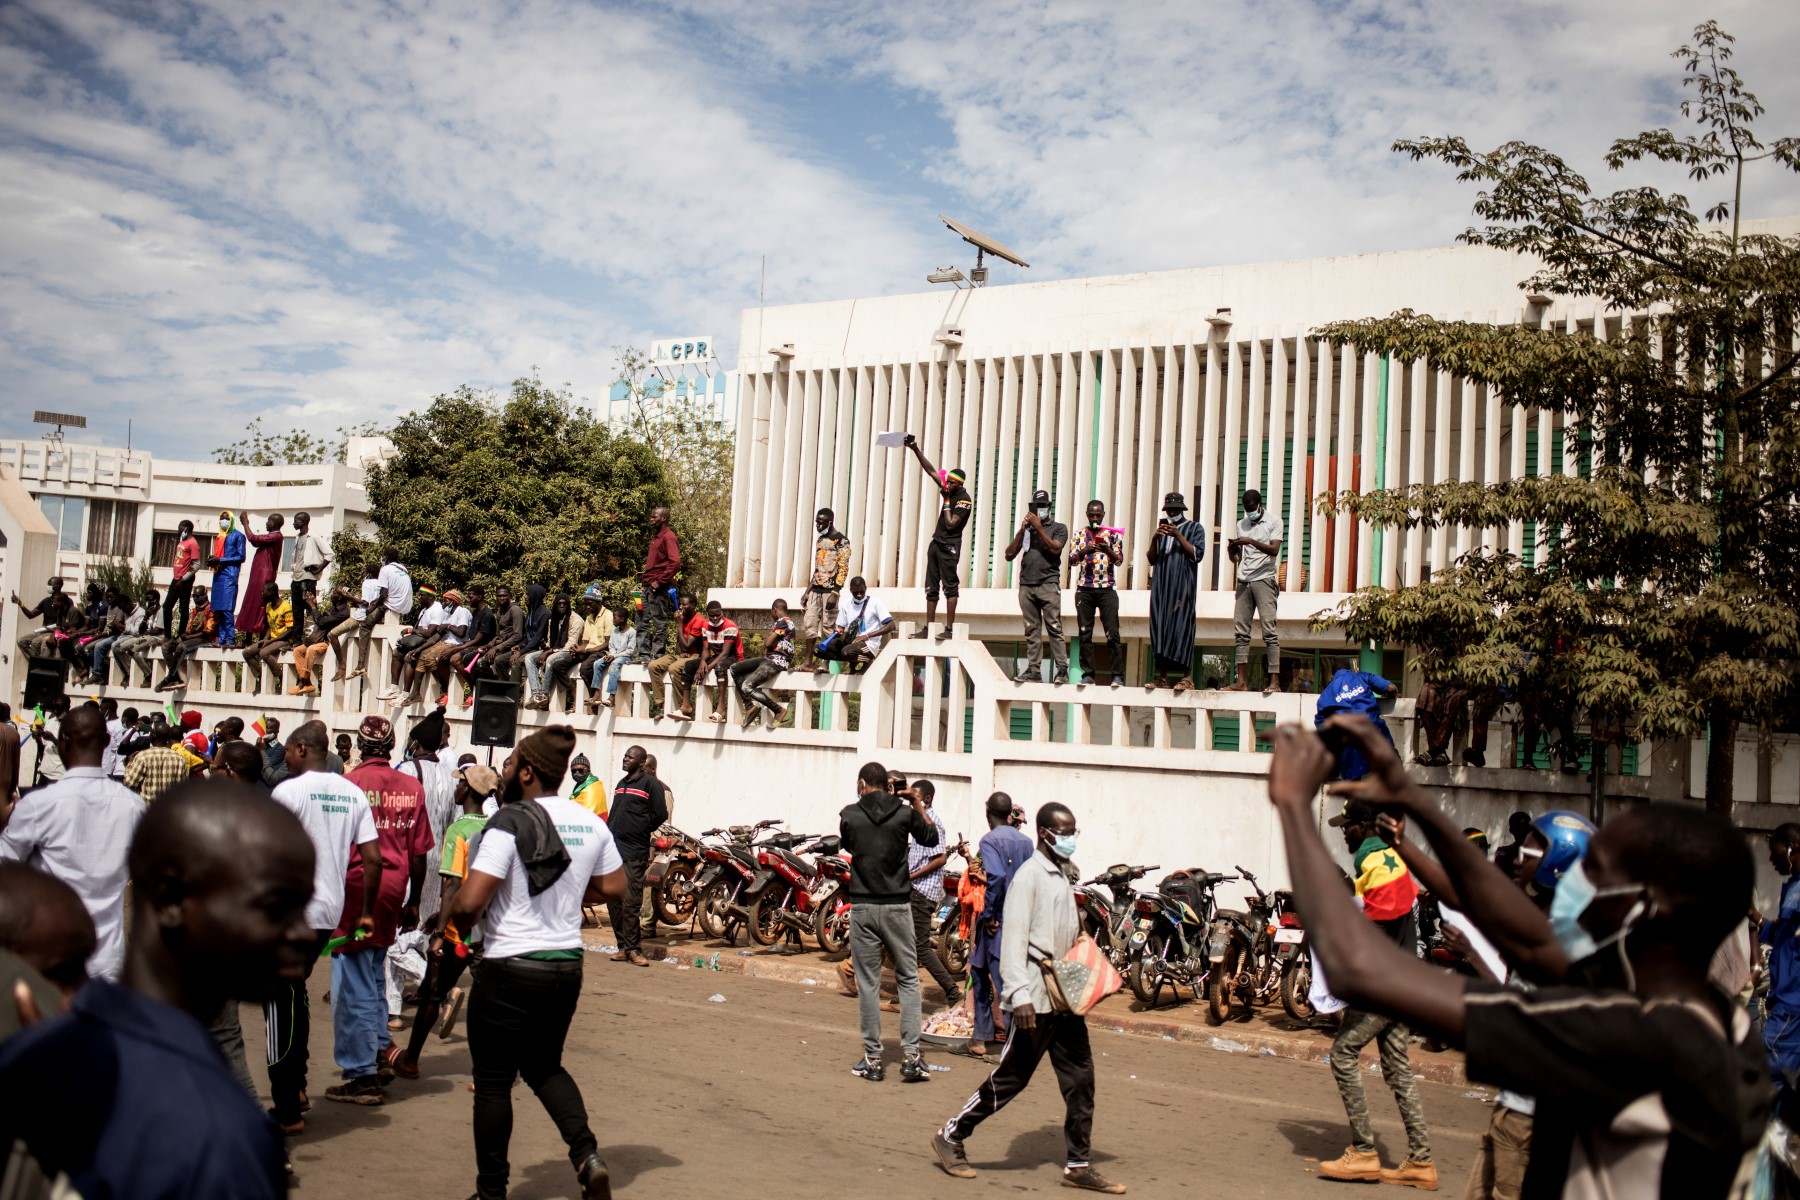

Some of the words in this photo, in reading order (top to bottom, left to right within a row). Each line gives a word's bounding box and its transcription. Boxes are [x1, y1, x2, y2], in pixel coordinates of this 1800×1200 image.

[671, 341, 707, 360] CPR
[338, 794, 351, 803] POUR
[364, 790, 381, 807] GA
[382, 791, 419, 812] Original
[331, 805, 350, 813] KOURA
[568, 824, 585, 833] POUR
